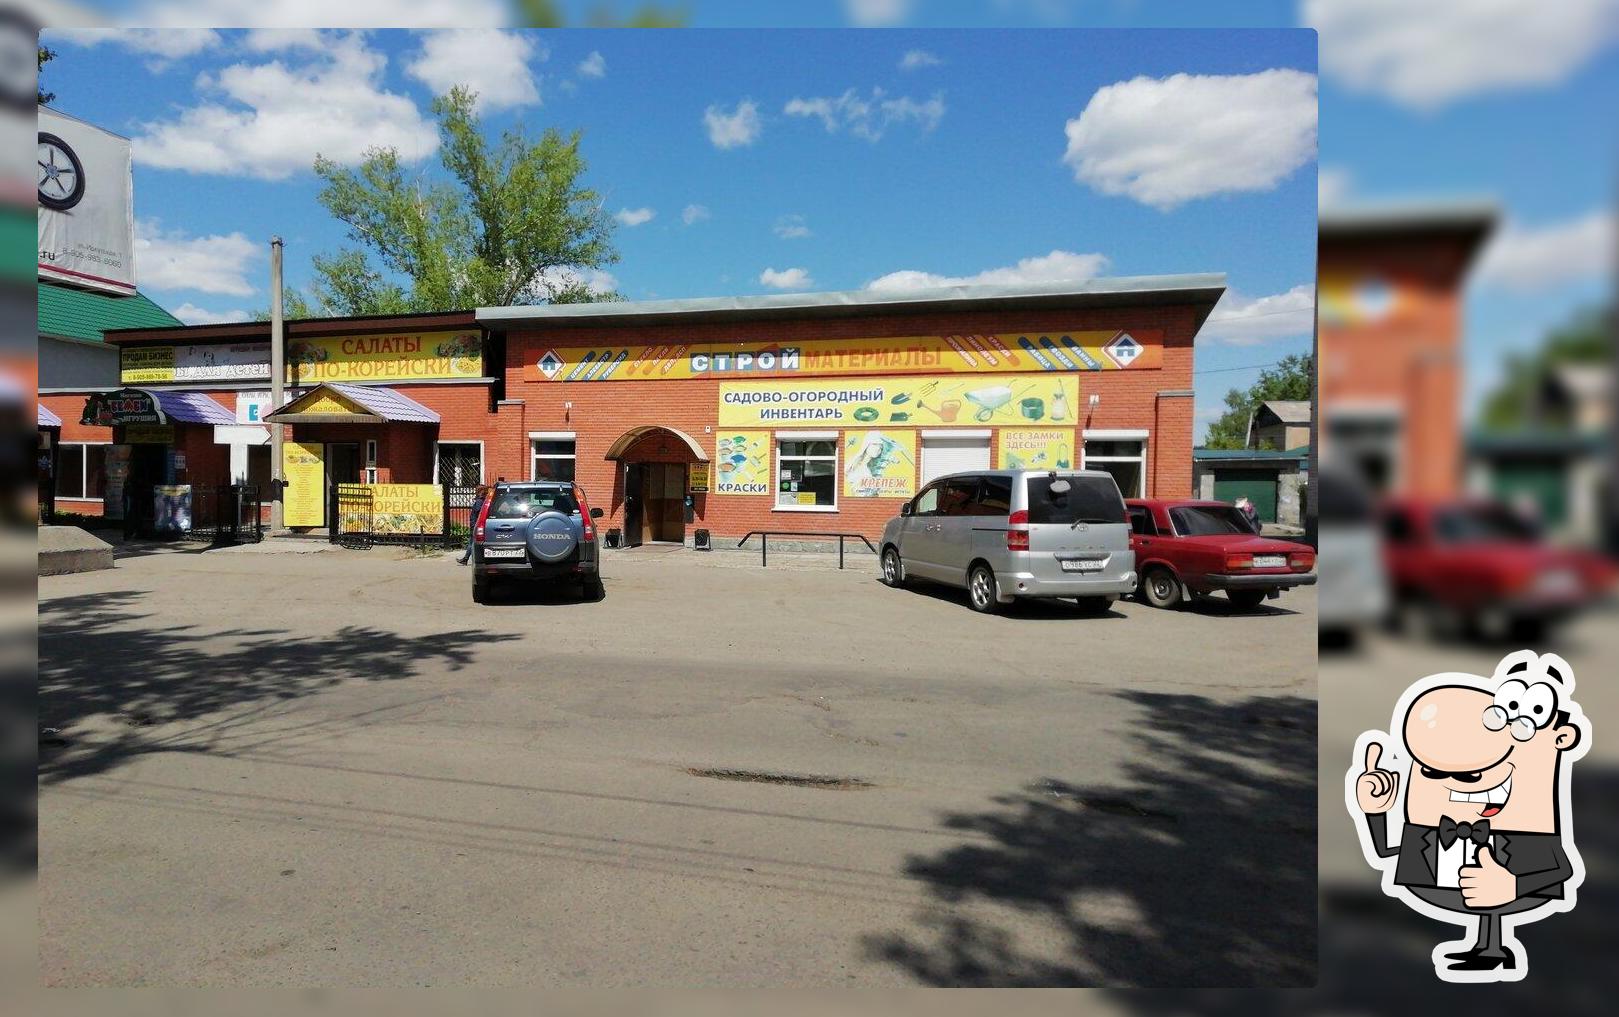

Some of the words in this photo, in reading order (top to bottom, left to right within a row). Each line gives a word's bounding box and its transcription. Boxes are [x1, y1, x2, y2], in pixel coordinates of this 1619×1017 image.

[341, 336, 422, 355] САЛАТЫ
[122, 352, 147, 363] ПРОДАМ
[148, 351, 173, 361] БИЗНЕС
[314, 356, 451, 378] ПО-КОРЕЙСКИ
[724, 388, 884, 404] САДОВО-ОГОРОДНЫЙ
[760, 408, 843, 419] ИНВЕНТАРЬ
[1006, 432, 1023, 440] ВСЕ
[1028, 432, 1064, 440] ЗАМКИ
[1007, 441, 1047, 450] ЗДЕСЬ!!!
[718, 482, 767, 493] КРАСКИ
[859, 477, 907, 488] КРЕПЕЖ
